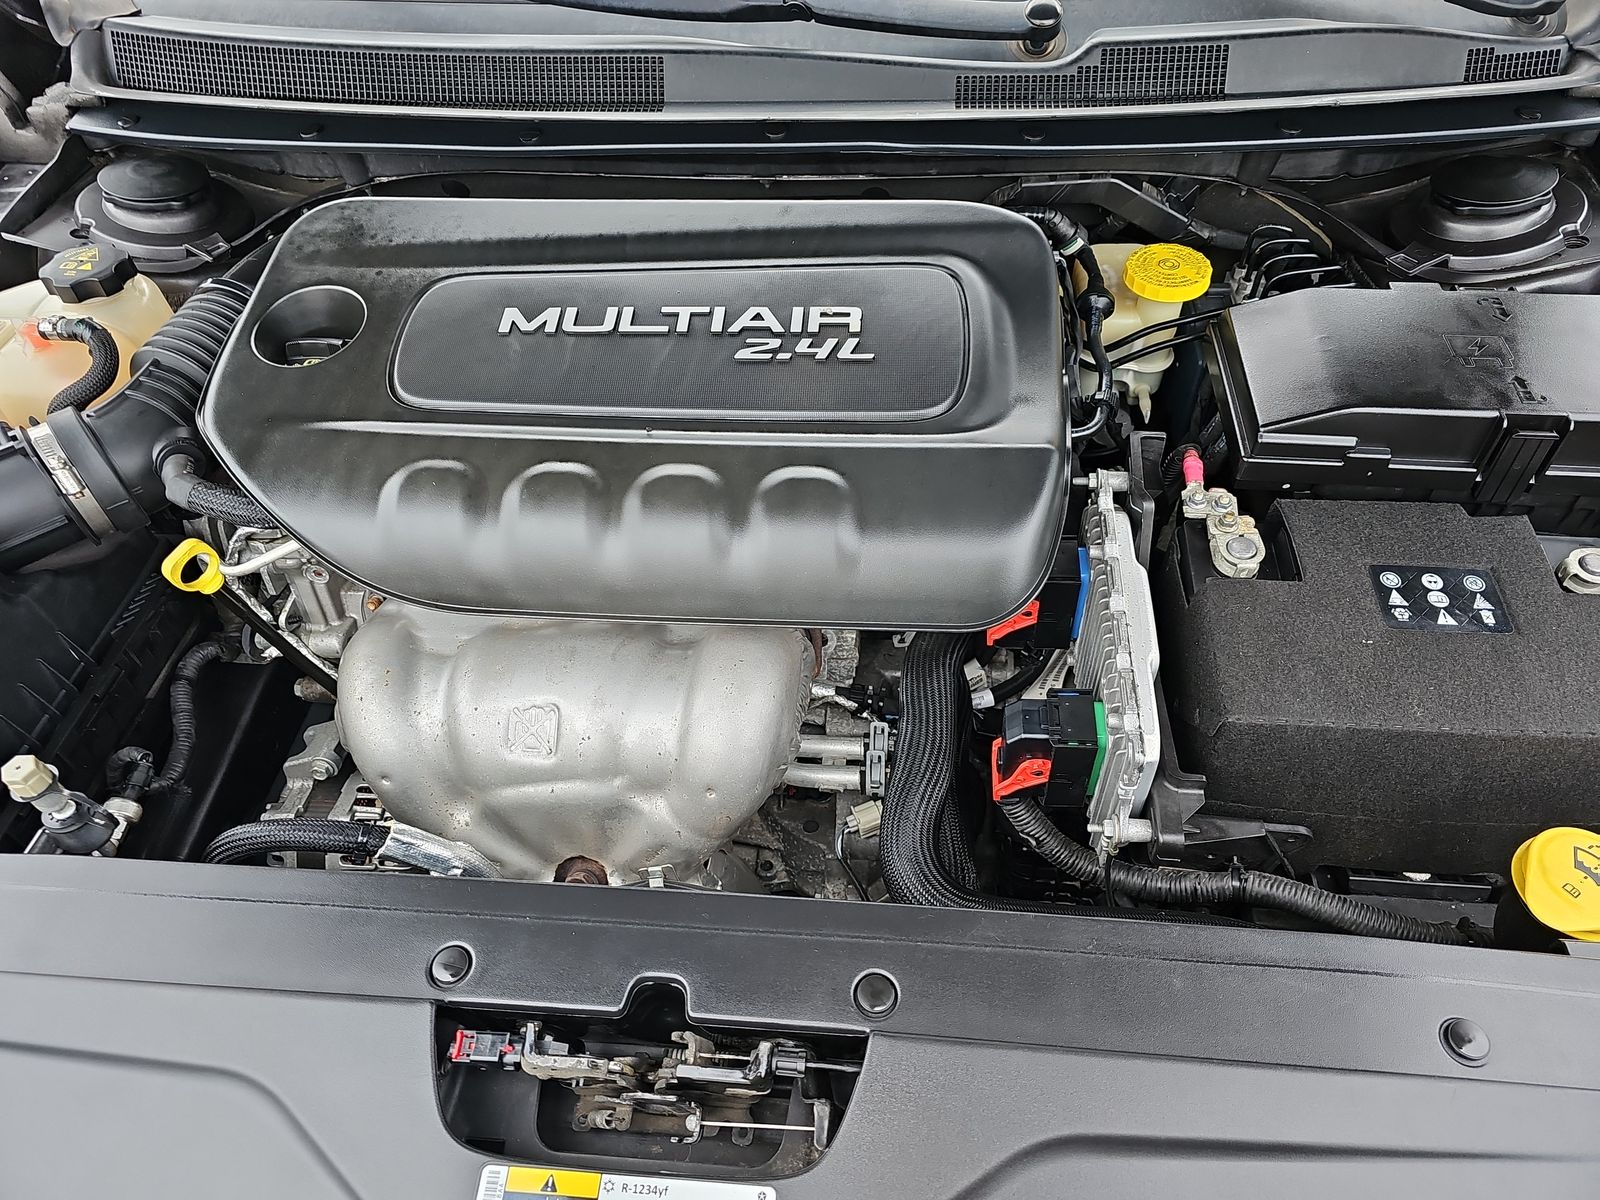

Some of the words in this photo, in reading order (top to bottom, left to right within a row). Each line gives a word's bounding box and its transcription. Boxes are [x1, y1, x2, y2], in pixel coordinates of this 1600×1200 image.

[498, 305, 863, 335] MULTIAIR
[733, 337, 875, 361] 2.4L
[621, 1182, 669, 1198] R-1234yf
